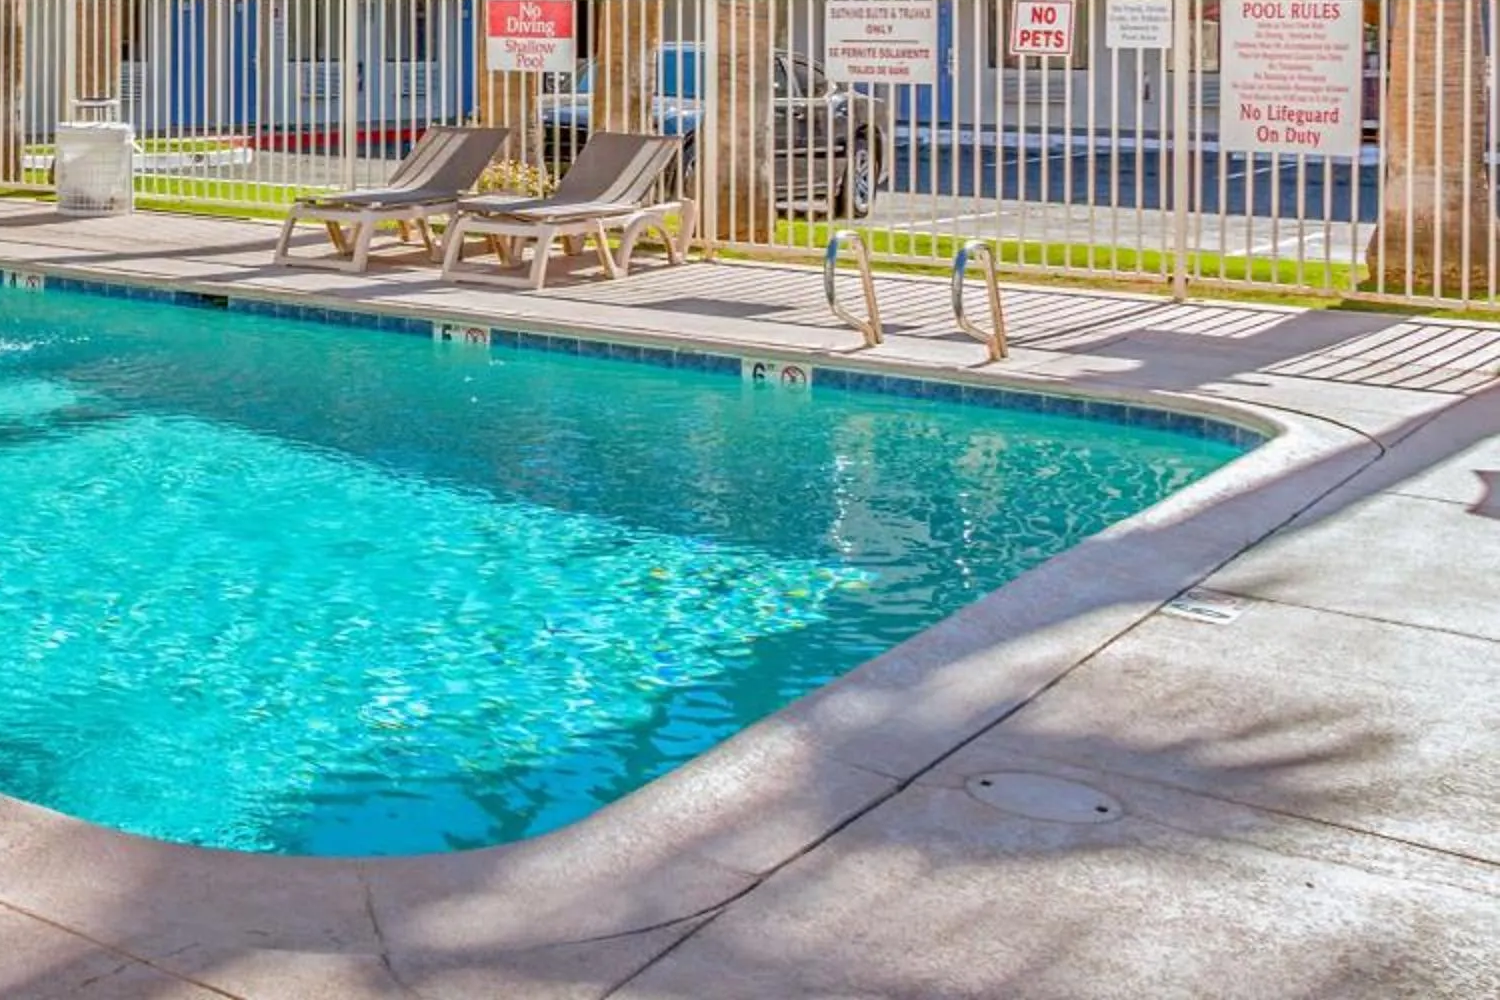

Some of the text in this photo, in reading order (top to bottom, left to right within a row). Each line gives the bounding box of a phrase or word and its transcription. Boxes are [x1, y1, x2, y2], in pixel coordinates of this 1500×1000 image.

[519, 2, 542, 19] No
[1031, 6, 1057, 24] NO
[1242, 2, 1340, 20] POOL RULES
[506, 16, 556, 37] Diving
[503, 39, 556, 54] Shallow
[1019, 29, 1065, 48] PETS
[516, 54, 544, 69] Pool
[1239, 104, 1340, 125] No Lifeguard
[1256, 126, 1321, 148] On Duty
